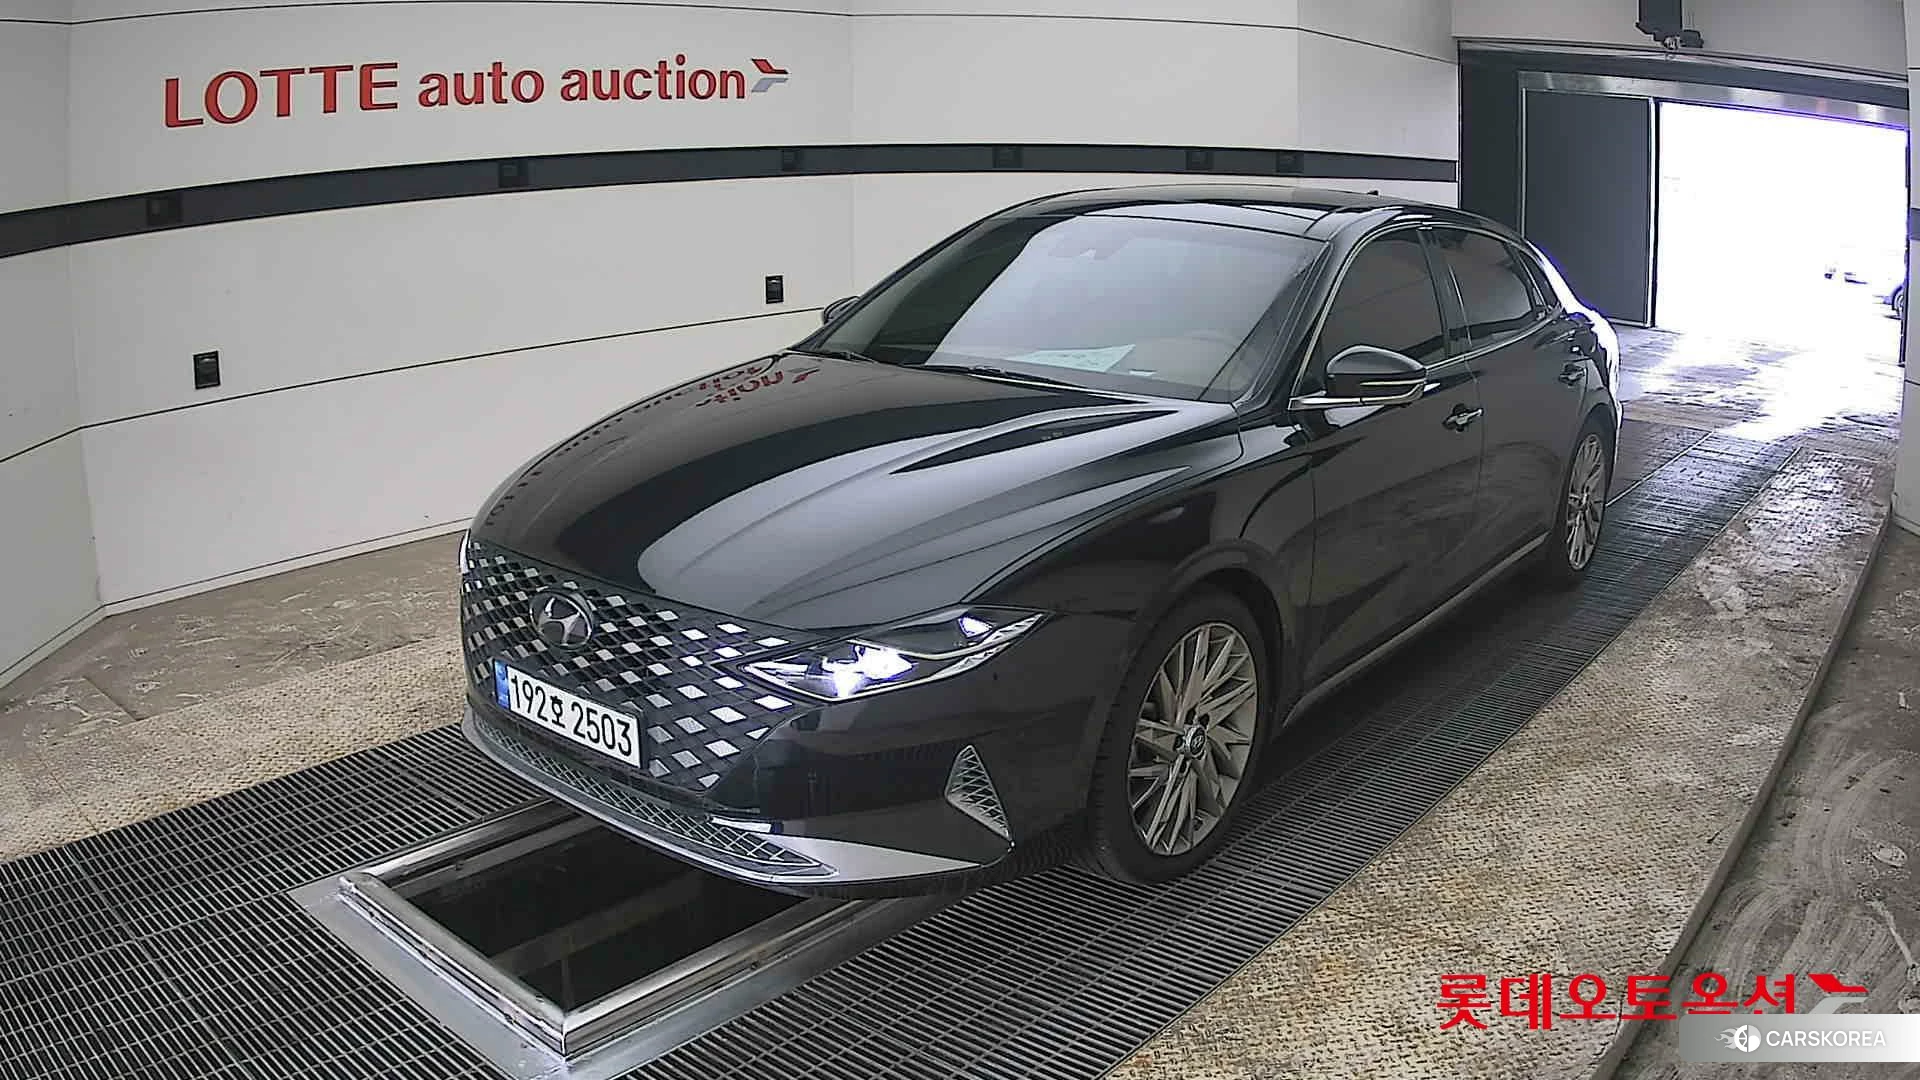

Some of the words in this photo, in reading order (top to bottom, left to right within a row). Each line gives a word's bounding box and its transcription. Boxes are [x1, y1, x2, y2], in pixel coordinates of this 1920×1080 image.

[165, 62, 398, 128] LOTTE
[418, 61, 545, 107] auto
[560, 53, 746, 101] auction
[511, 675, 565, 728] 192호
[571, 701, 632, 757] 2503
